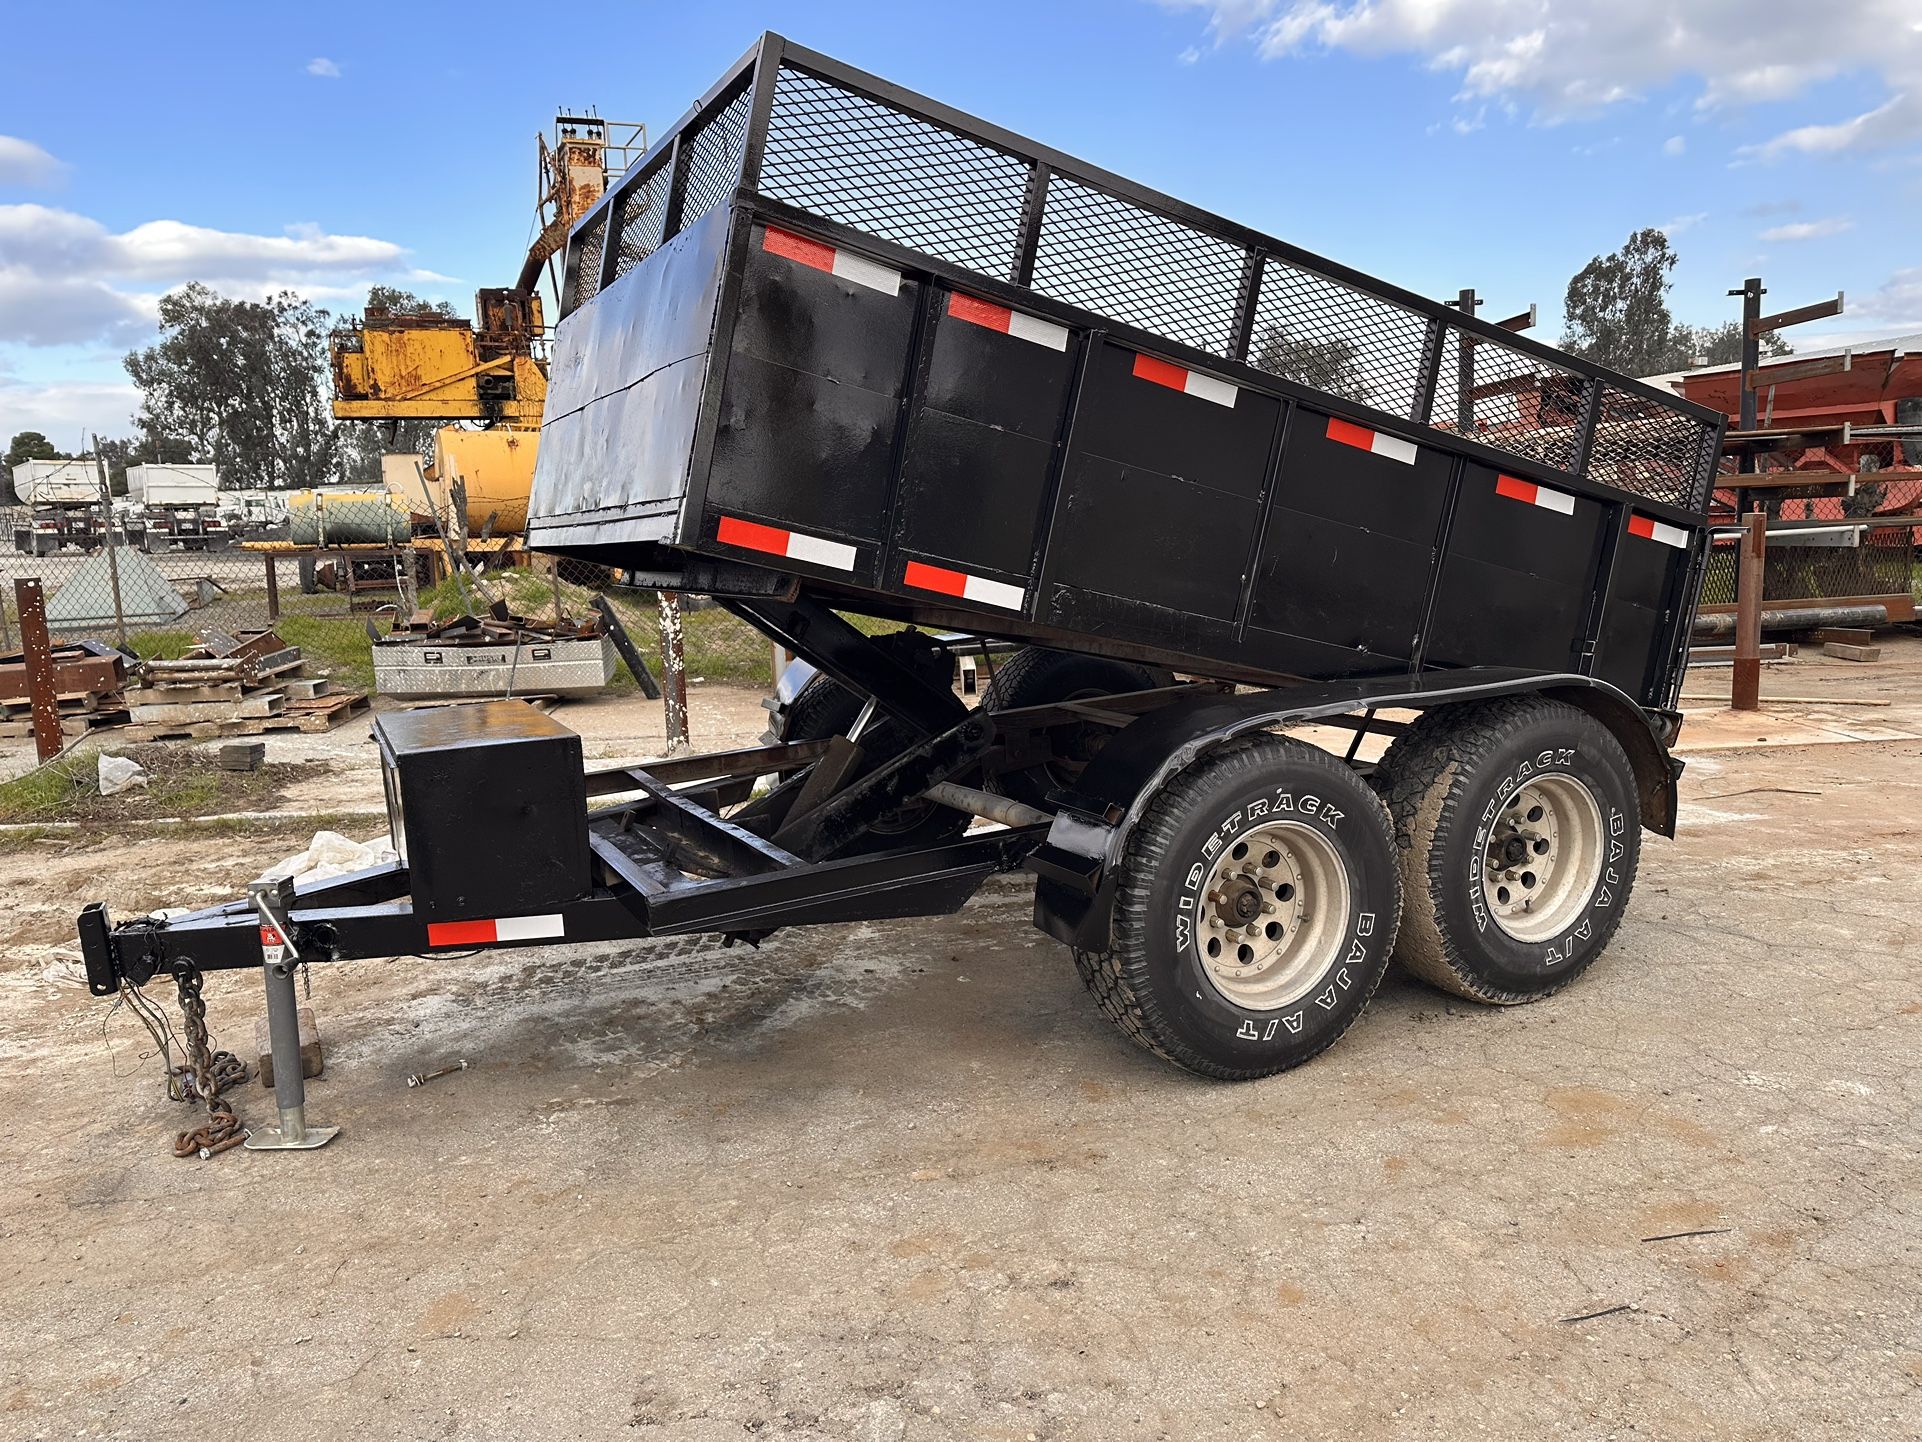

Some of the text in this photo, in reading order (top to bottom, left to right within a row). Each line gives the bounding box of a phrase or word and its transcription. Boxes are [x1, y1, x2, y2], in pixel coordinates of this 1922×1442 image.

[1176, 793, 1345, 953] WIDETRACK
[1469, 749, 1575, 933] WIDETRACK
[1545, 813, 1625, 965] BAJA A/T
[1236, 913, 1376, 1041] BAJA A/T
